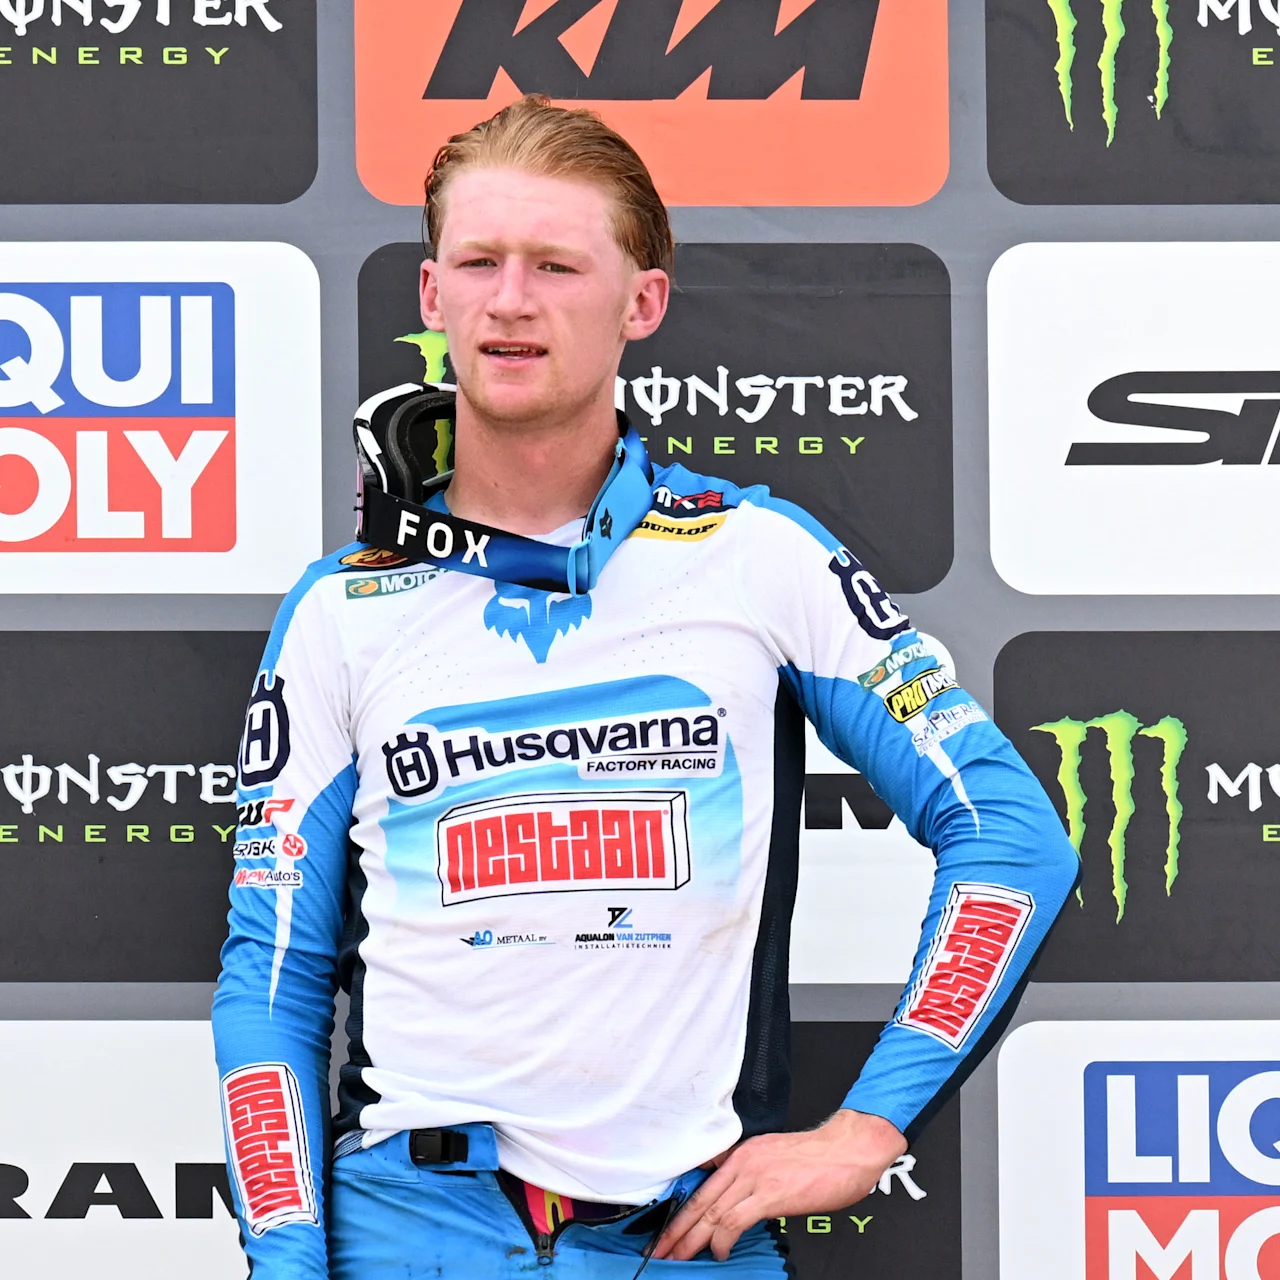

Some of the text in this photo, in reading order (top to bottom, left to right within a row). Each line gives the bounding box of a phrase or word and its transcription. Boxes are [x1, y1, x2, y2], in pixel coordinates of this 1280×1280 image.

[396, 510, 491, 568] FOX
[442, 713, 721, 780] Husqvarna
[586, 757, 716, 773] FACTORY RACING
[447, 809, 667, 893] nestaan
[496, 933, 537, 945] METAAL
[575, 933, 671, 942] AQUALON VAN ZUTPHEN
